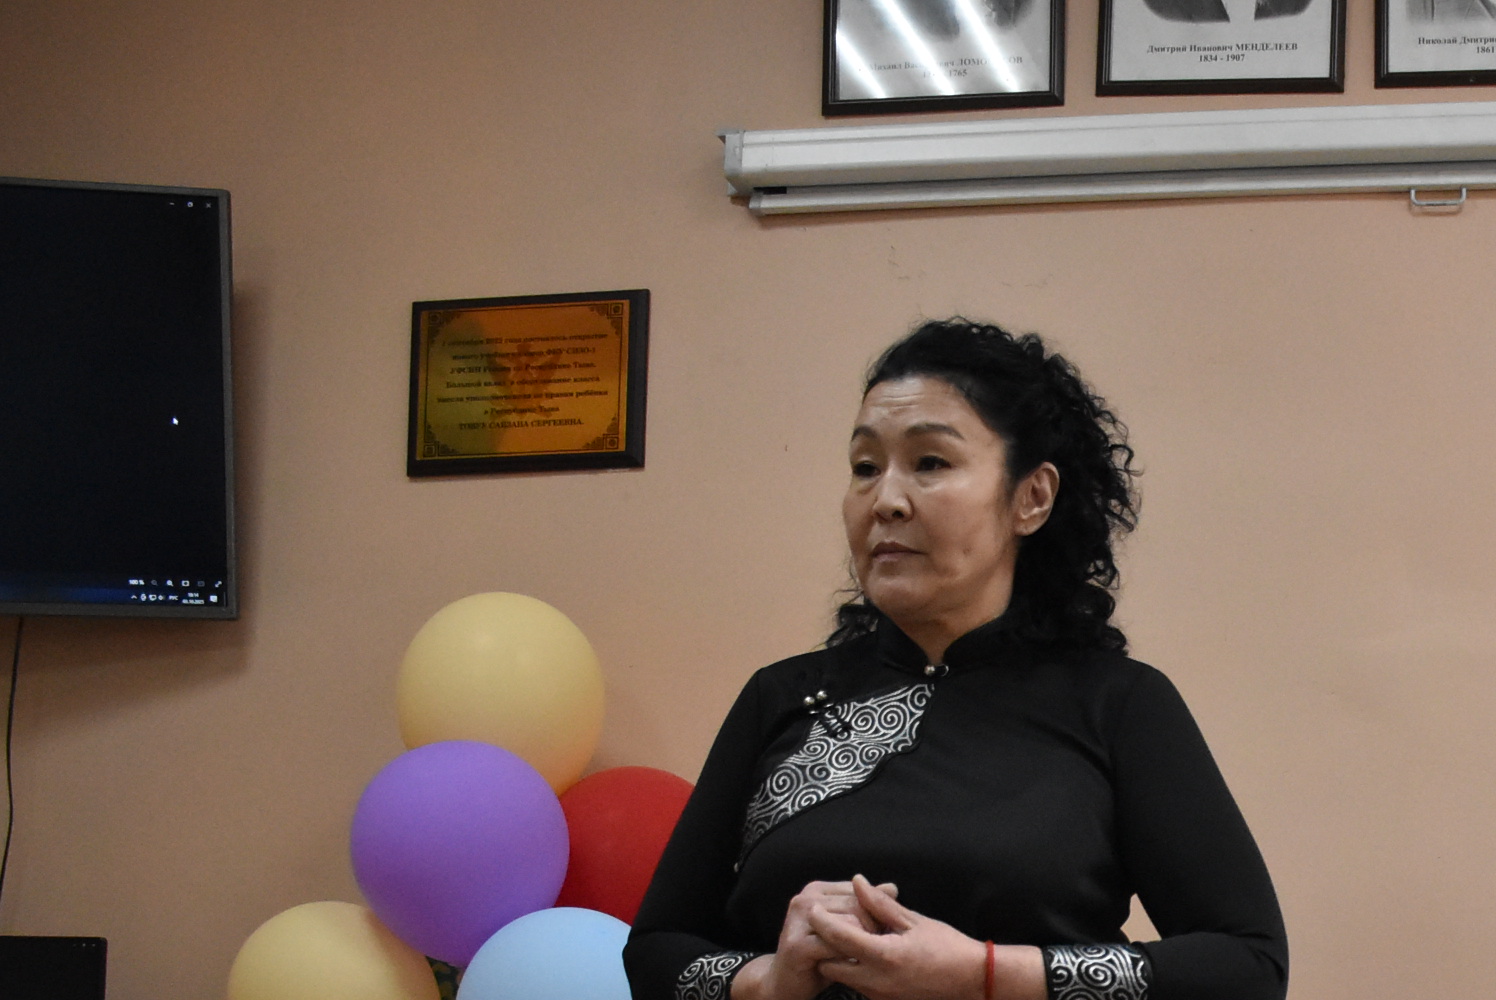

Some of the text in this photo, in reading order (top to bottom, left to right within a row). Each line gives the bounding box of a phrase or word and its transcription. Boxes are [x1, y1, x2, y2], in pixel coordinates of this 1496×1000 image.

[1418, 36, 1457, 45] Николай
[1147, 42, 1298, 53] Дмитрий Иванович МЕНДЕЛЕЕВ
[1476, 45, 1496, 54] 1861
[1199, 54, 1218, 63] 1834
[1225, 53, 1245, 62] 1907
